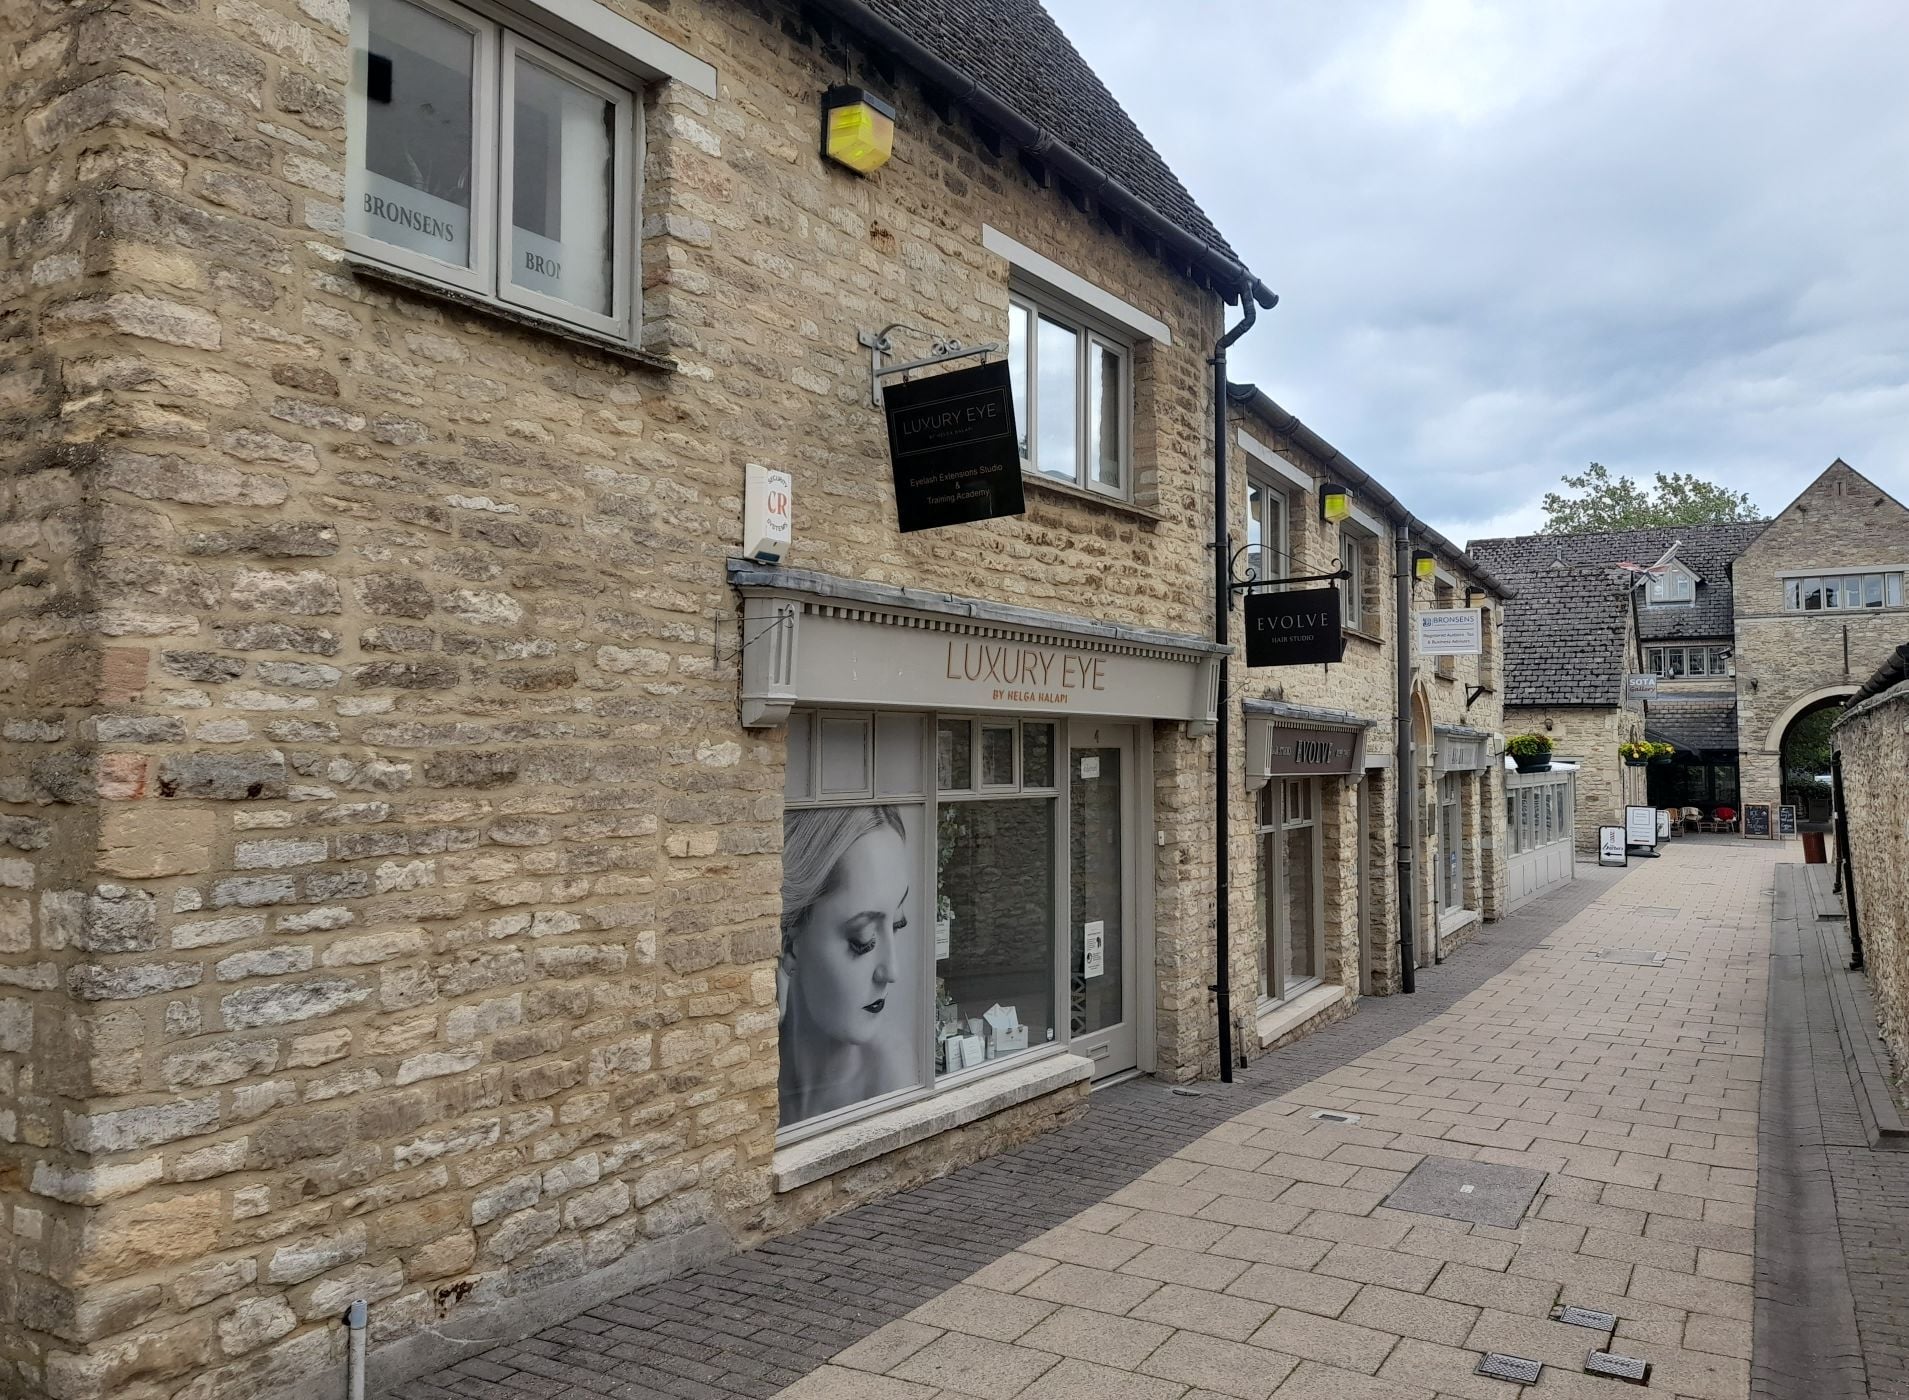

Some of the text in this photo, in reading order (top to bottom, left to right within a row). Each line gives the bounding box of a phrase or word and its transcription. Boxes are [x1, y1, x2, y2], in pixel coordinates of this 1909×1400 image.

[363, 193, 454, 242] BRONSENS
[903, 410, 961, 435] LUXURY
[966, 403, 996, 422] EYE
[910, 463, 1003, 488] Eyelash Extensions Studio
[955, 481, 961, 490] &
[767, 490, 788, 518] CR
[927, 488, 990, 505] Training Academy
[1257, 612, 1329, 631] EVOLVE
[1433, 616, 1475, 624] BRONSENS
[1271, 634, 1314, 644] HAIR STUDIO
[946, 641, 1107, 691] LUXURY EYE
[1629, 678, 1655, 686] SOTA
[992, 689, 1068, 704] BY HELGA HALAPI
[1295, 739, 1333, 764] EVOLVE
